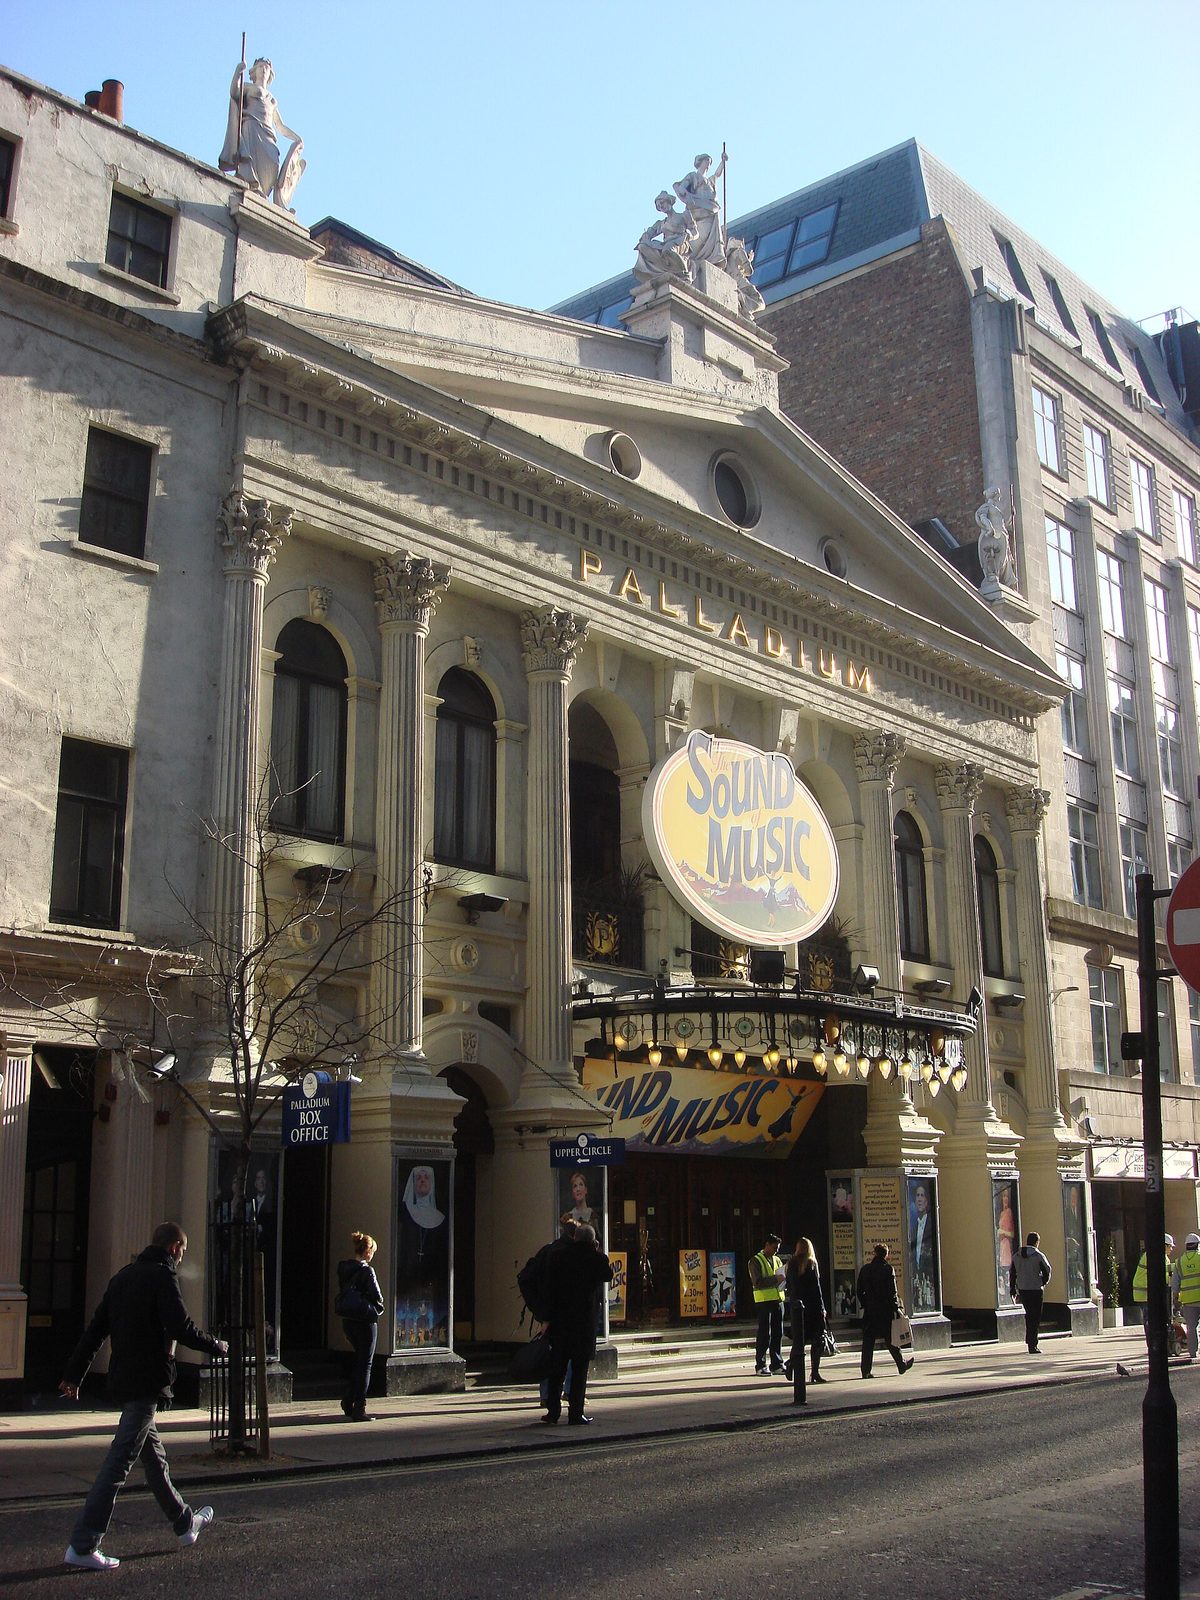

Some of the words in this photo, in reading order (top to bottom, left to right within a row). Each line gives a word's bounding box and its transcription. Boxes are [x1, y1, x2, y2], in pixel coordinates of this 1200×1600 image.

[580, 548, 871, 693] PALLADIUM
[711, 751, 729, 772] The
[751, 808, 762, 829] of
[706, 816, 811, 883] MUSIC
[291, 1098, 330, 1109] PALLADIUM
[597, 1070, 672, 1121] UND
[300, 1110, 321, 1125] BOX
[641, 1110, 659, 1129] of
[643, 1079, 780, 1146] MUSIC
[291, 1126, 328, 1142] OFFICE
[555, 1147, 581, 1158] UPPER
[582, 1145, 612, 1156] CIRCLE
[608, 1272, 627, 1291] USIC
